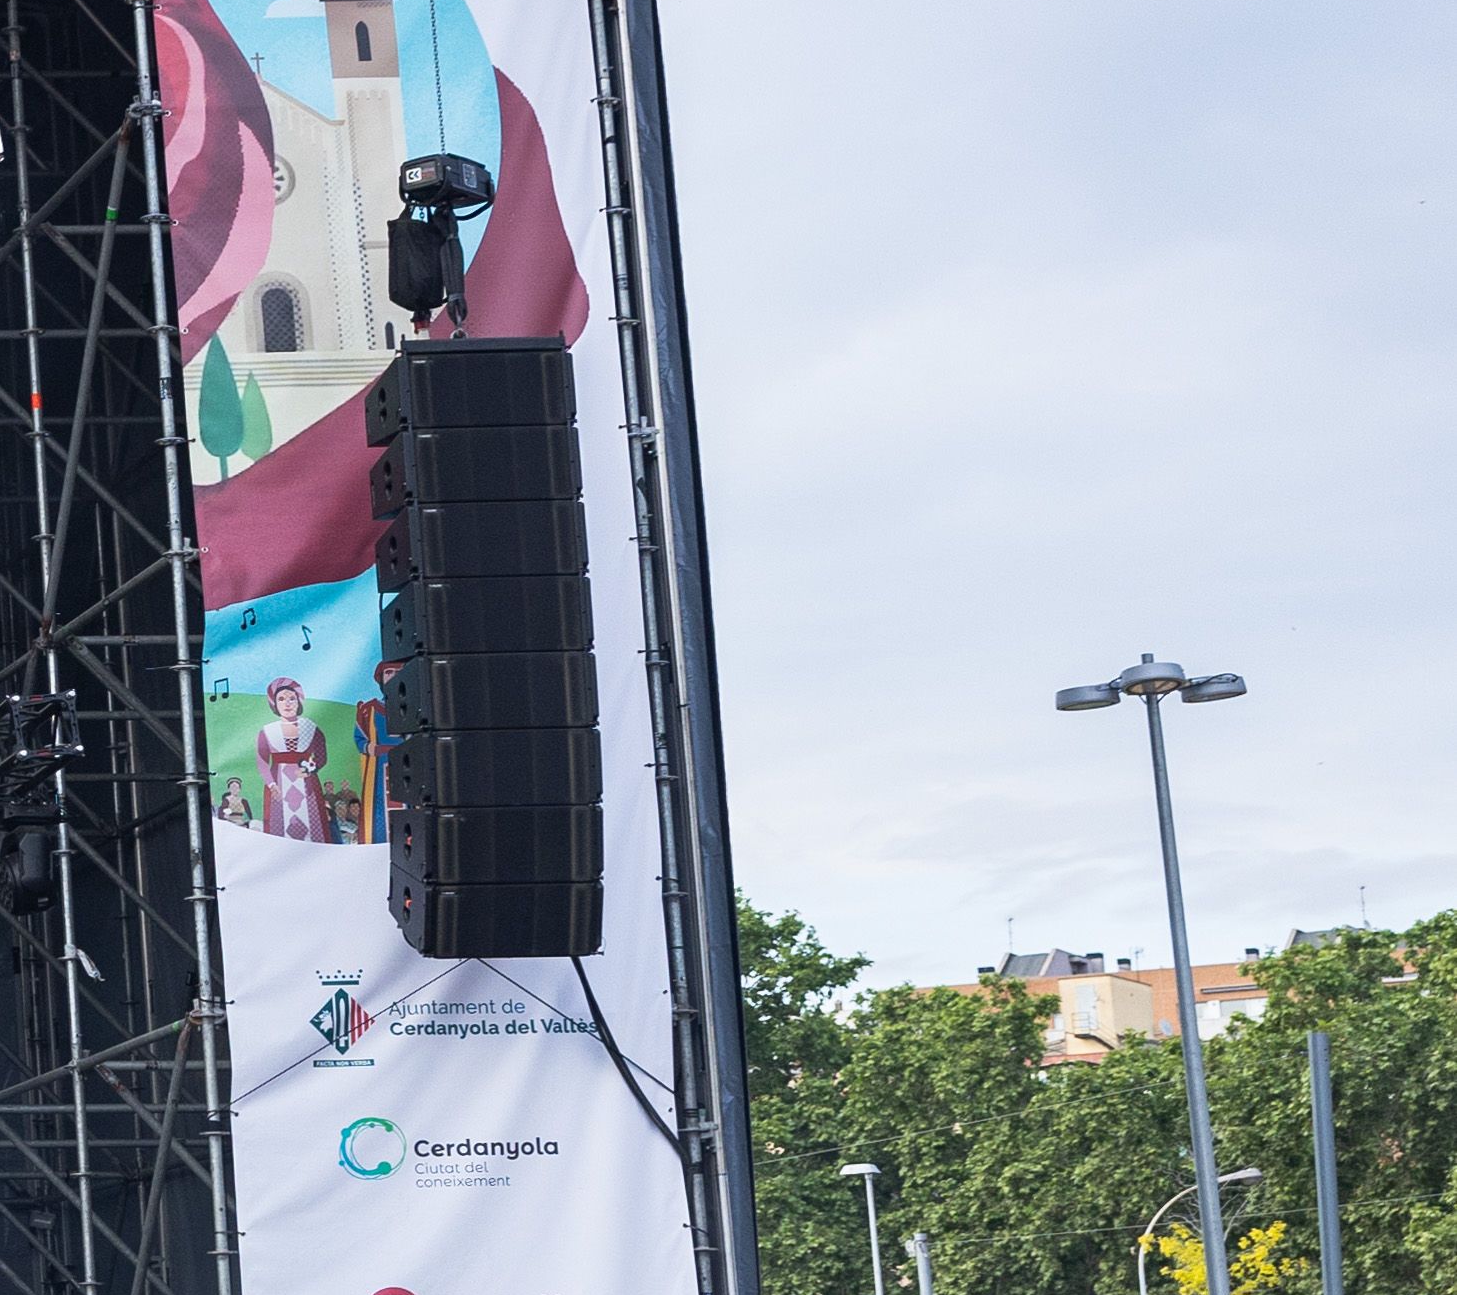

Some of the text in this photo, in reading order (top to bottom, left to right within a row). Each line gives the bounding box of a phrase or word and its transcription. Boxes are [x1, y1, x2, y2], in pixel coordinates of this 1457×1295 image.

[389, 998, 525, 1017] Ajuntament de
[390, 1017, 598, 1039] Cerdanyola del Vallès
[414, 1137, 559, 1162] Cerdanyola
[415, 1162, 488, 1175] Ciutat del
[416, 1175, 511, 1189] coneixement
